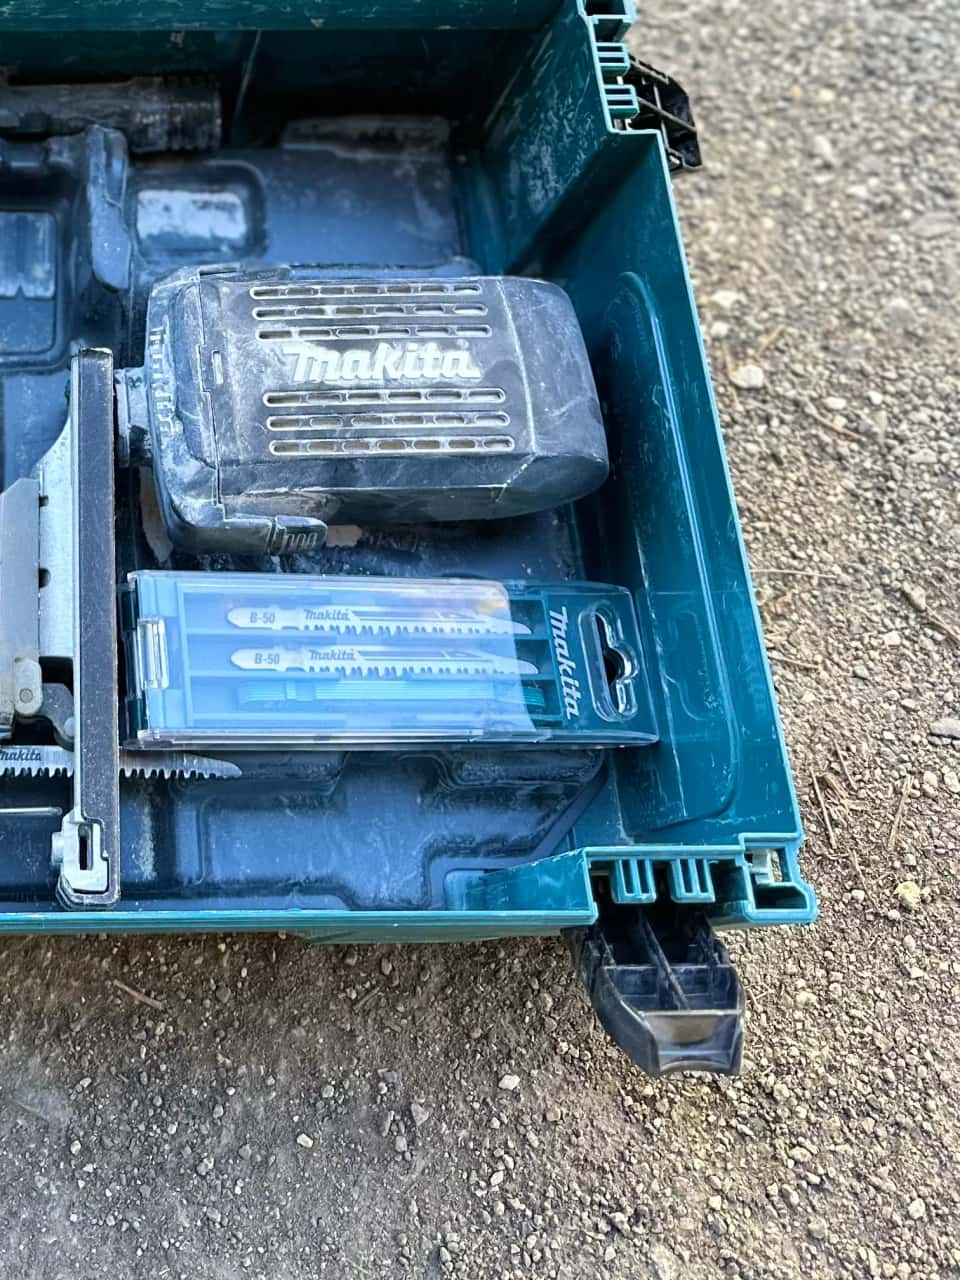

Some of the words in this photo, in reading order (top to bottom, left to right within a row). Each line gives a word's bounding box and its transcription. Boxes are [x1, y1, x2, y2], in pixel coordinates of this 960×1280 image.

[283, 341, 480, 382] Makita
[250, 611, 275, 623] B-50
[303, 608, 350, 621] Makita
[254, 652, 280, 665] B-50
[309, 648, 356, 661] Makita
[549, 605, 582, 720] Makita
